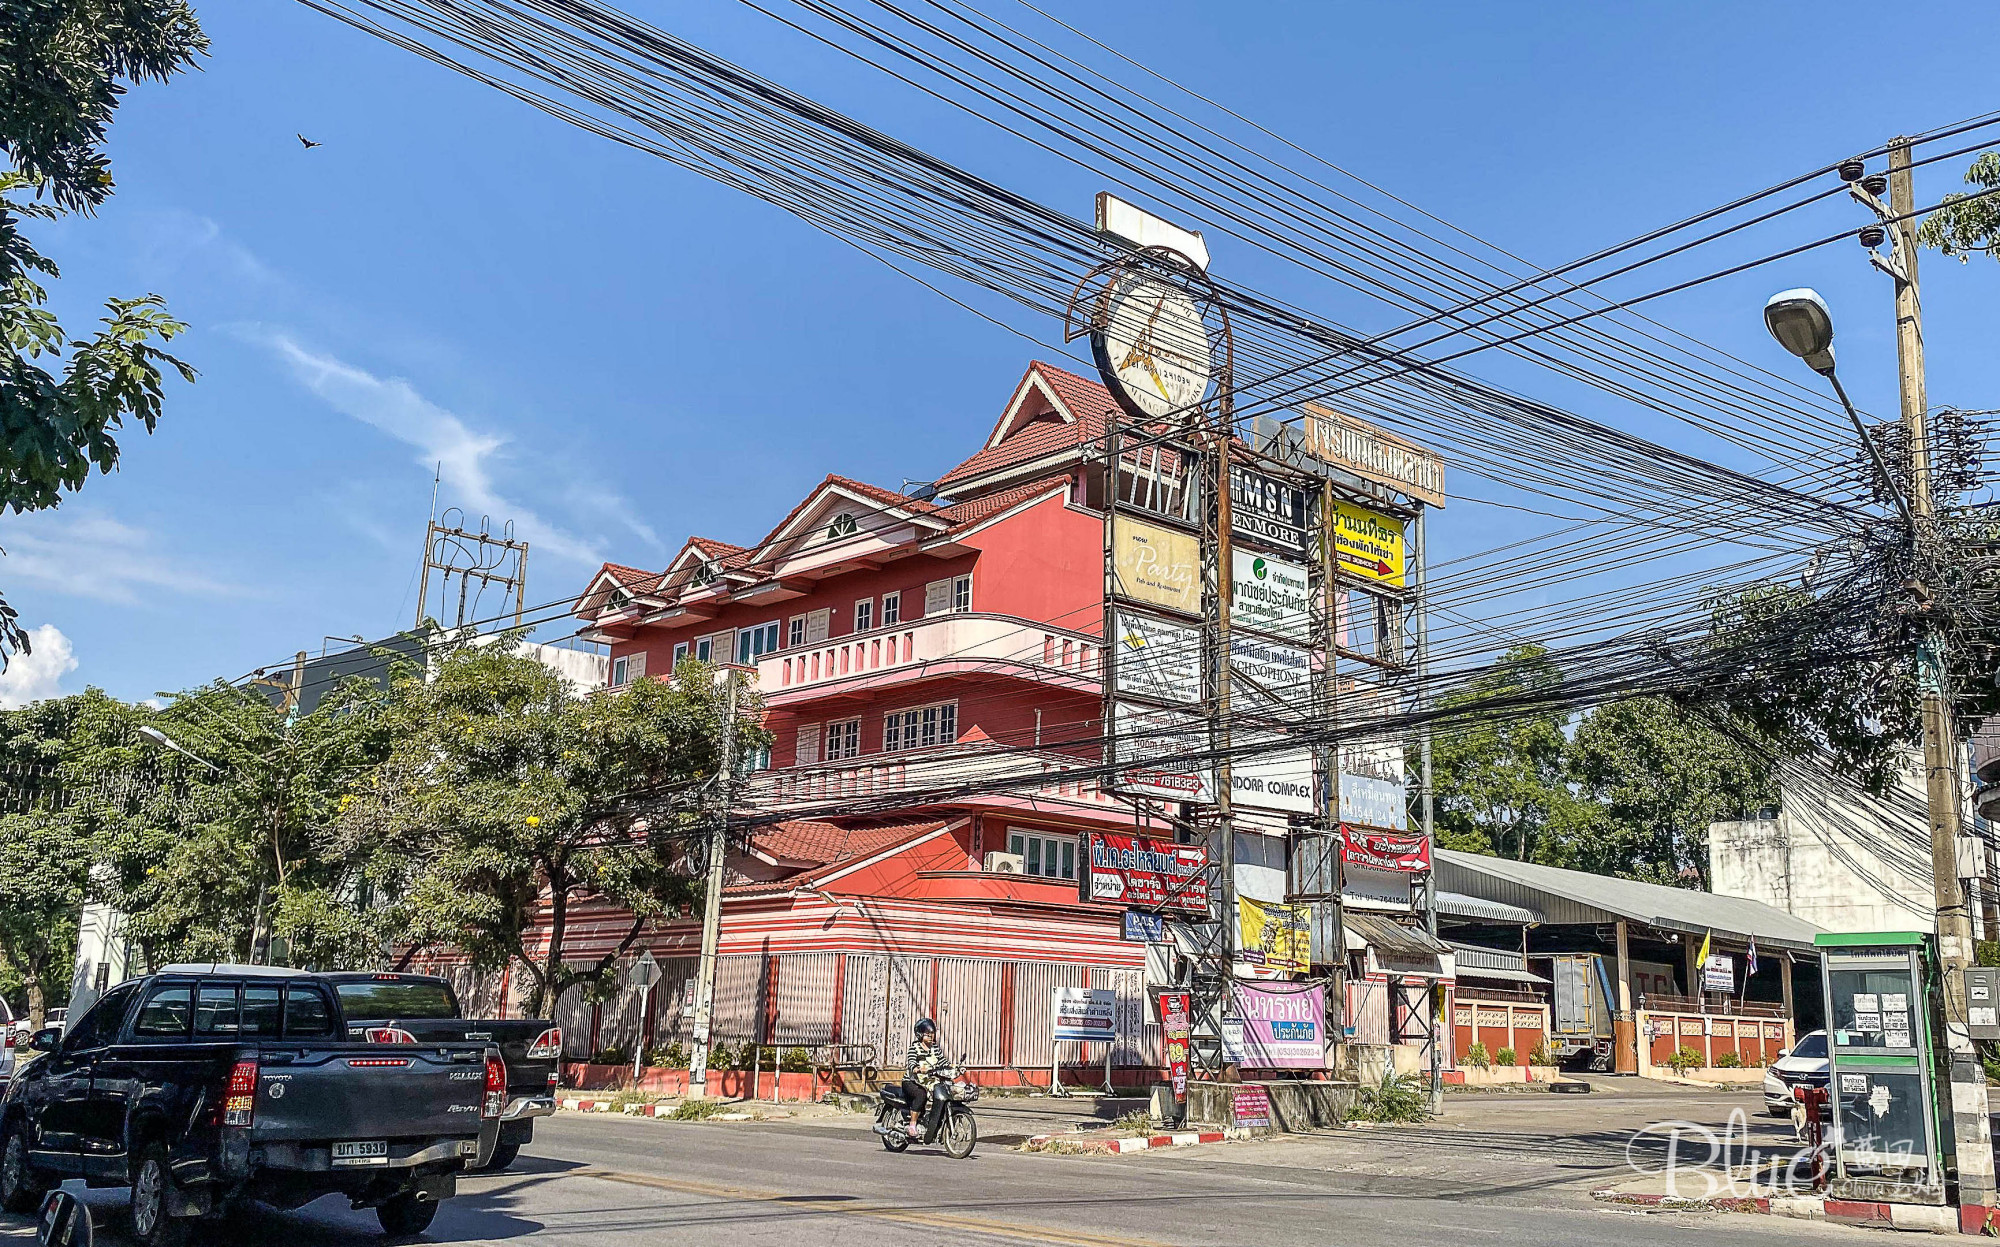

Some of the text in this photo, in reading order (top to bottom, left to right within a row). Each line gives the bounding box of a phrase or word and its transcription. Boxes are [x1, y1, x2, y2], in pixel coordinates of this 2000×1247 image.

[1244, 474, 1293, 518] MSN
[1231, 512, 1300, 544] ENMORE
[1334, 533, 1394, 560] ห้องพักให้เช่า
[1133, 545, 1195, 604] Party
[1231, 658, 1301, 685] ECHNOPHONE
[1232, 776, 1311, 799] NDORA COMPLEX
[1094, 876, 1122, 893] จำหน่าย
[1273, 1022, 1314, 1040] ประกันภัย
[449, 1072, 483, 1080] HILUX
